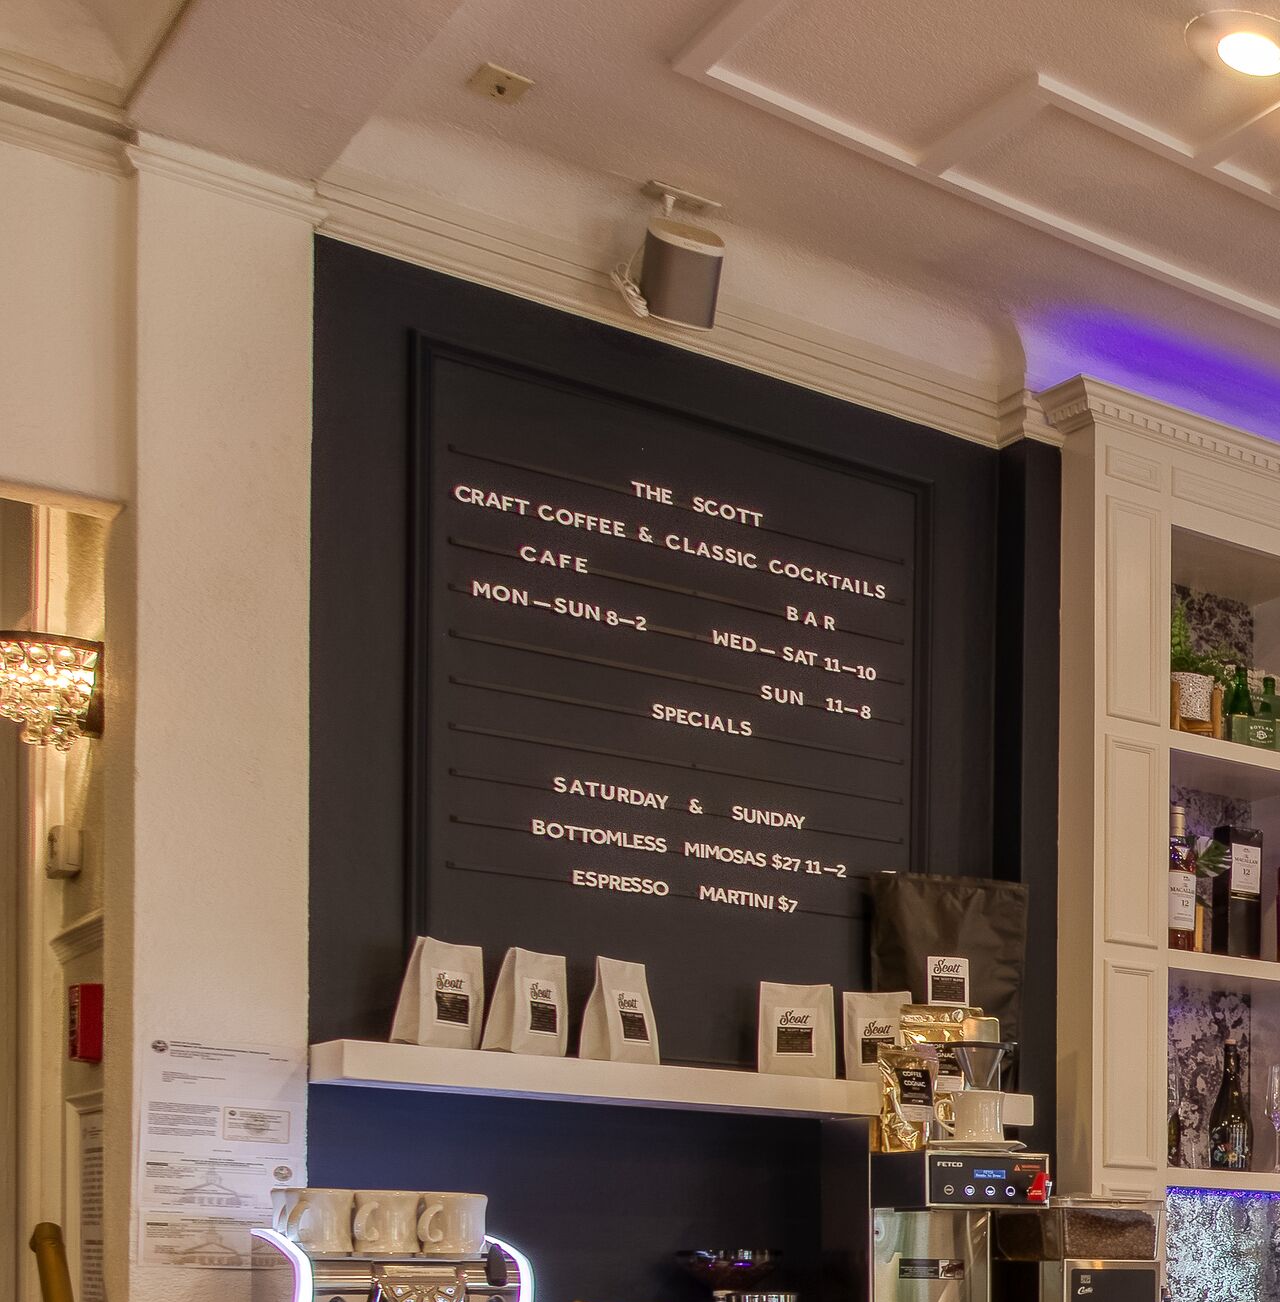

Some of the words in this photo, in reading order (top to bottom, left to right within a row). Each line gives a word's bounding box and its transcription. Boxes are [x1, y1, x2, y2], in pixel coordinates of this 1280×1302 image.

[632, 481, 673, 505] THE
[693, 497, 763, 527] SCOTT
[455, 486, 530, 515] CRAFT
[538, 505, 626, 538] COFFEE
[639, 527, 653, 543] &
[666, 535, 757, 569] CLASSIC
[769, 560, 886, 600] COCKTAILS
[521, 546, 588, 573] CAFE
[787, 606, 836, 631] BAR
[783, 647, 818, 666] SAT
[761, 685, 804, 706] SUN
[652, 704, 753, 737] SPECIALS
[554, 777, 668, 810] SATURDAY
[689, 799, 703, 814] &
[732, 806, 804, 829] SUNDAY
[533, 819, 667, 853] BOTTOMLESS
[685, 842, 766, 868] MIMOSAS
[772, 854, 801, 873] $27
[1243, 868, 1251, 876] 12
[573, 870, 669, 896] ESPRESSO
[700, 886, 774, 910] MARTINI
[778, 895, 798, 914] $7
[1182, 899, 1190, 907] 12
[934, 959, 963, 974] Scott
[436, 972, 465, 990] Scott
[530, 982, 552, 1000] Scott
[618, 992, 639, 1010] Scott
[780, 1010, 811, 1026] Scott
[864, 1021, 893, 1037] Scott
[904, 1080, 926, 1088] COGNAC
